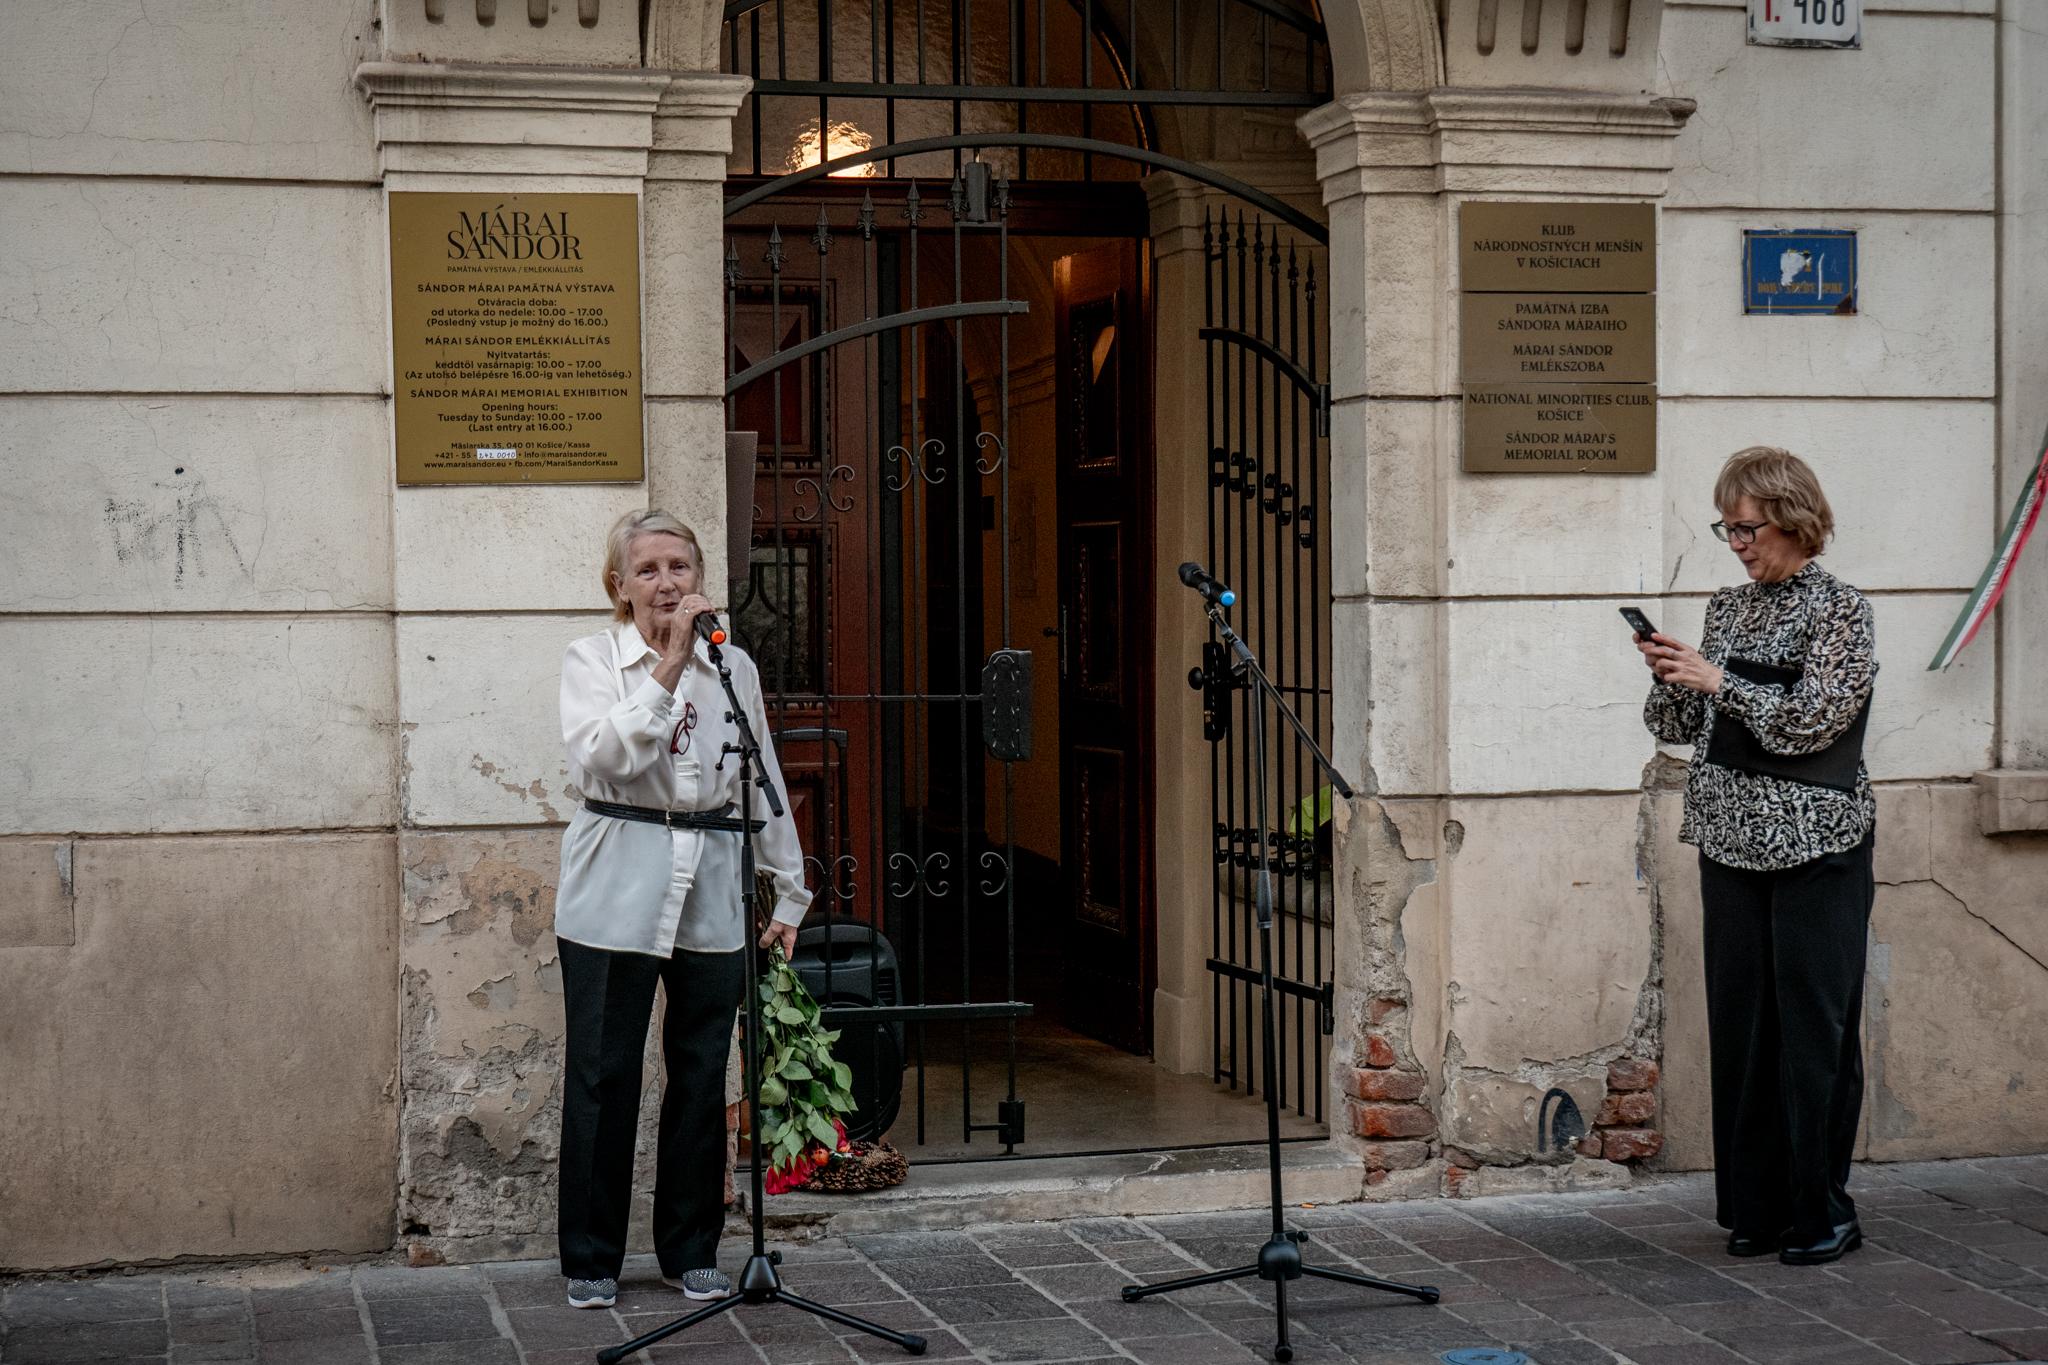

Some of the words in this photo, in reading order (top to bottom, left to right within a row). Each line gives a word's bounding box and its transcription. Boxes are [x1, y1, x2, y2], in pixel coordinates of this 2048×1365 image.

[458, 204, 569, 245] MÁRAI
[1542, 225, 1575, 235] KLUB
[447, 226, 583, 260] SÁNDOR
[1474, 239, 1590, 252] NÁRODNOSTNÝCH
[1595, 240, 1643, 252] MENŠÍN
[1517, 258, 1525, 267] V
[1530, 256, 1600, 268] KOŠICIACH
[484, 265, 516, 273] VÝSTAVA
[418, 283, 465, 292] SÁNDOR
[469, 283, 504, 292] MÁRAI
[566, 283, 614, 292] VÝSTAVA
[478, 298, 525, 306] Otváracia
[529, 298, 556, 306] doba:
[431, 308, 444, 316] od
[448, 308, 479, 316] utorka
[483, 308, 495, 316] do
[499, 308, 535, 316] nedele:
[539, 308, 566, 316] 10.00
[578, 308, 602, 316] 17.00
[1581, 304, 1609, 314] IZBA
[427, 318, 476, 327] (Posledný
[480, 319, 507, 327] vstup
[510, 318, 518, 327] je
[522, 318, 554, 327] možný
[558, 318, 571, 326] do
[574, 318, 608, 327] 16.00.)
[1498, 318, 1560, 330] SÁNDORA
[1565, 318, 1627, 330] MÁRAIHO
[426, 336, 461, 345] MÁRAI
[465, 336, 512, 345] SÁNDOR
[516, 335, 610, 345] EMLÉKKIÁLLÍTÁS
[1513, 343, 1554, 355] MÁRAI
[1559, 343, 1613, 355] SÁNDOR
[487, 351, 550, 360] Nyitvatartás:
[477, 361, 533, 370] vasárnapig:
[1521, 359, 1605, 371] EMLÉKSZOBA
[406, 371, 422, 379] (Az
[426, 371, 456, 379] utolsó
[460, 371, 509, 380] belépésre
[512, 371, 552, 379] 16.00-ig
[411, 388, 458, 397] SÁNDOR
[462, 388, 497, 397] MÁRAI
[1469, 394, 1532, 404] NATIONAL
[1537, 394, 1612, 405] MINORITIES
[482, 403, 524, 412] Opening
[438, 414, 478, 422] Tuesday
[496, 413, 534, 422] Sunday:
[1538, 408, 1583, 421] KOŠICE
[469, 424, 493, 432] (Last
[497, 424, 522, 432] entry
[538, 423, 572, 431] 16.00.)
[1506, 431, 1559, 443] SÁNDOR
[1564, 431, 1616, 444] MÁRAI'S
[537, 441, 590, 449] Košice/Kassa
[1504, 449, 1573, 460] MEMORIAL
[1577, 449, 1617, 460] ROOM
[424, 460, 506, 468] www.maraisandor.eu
[514, 460, 618, 468] fb.com/MaraiSandorKassa
